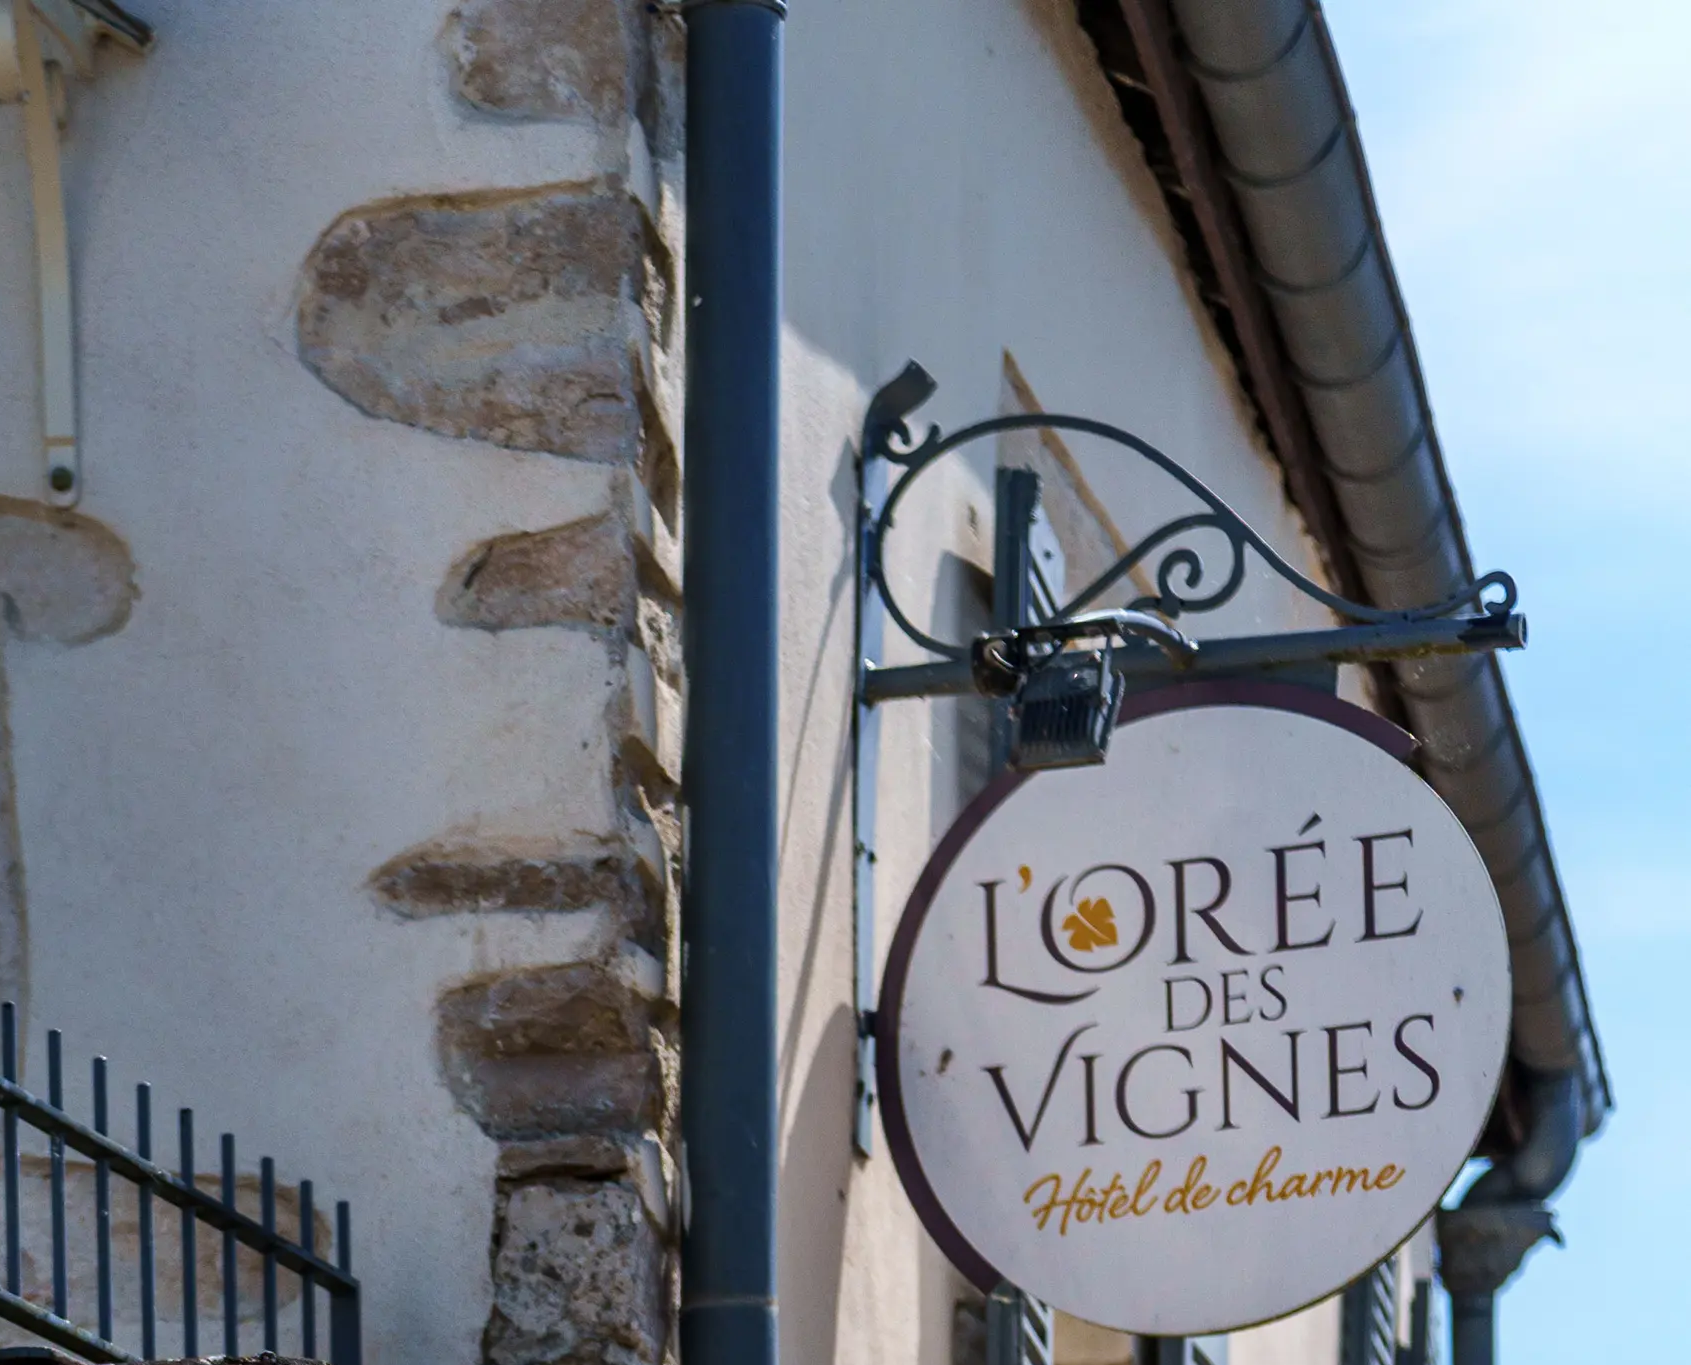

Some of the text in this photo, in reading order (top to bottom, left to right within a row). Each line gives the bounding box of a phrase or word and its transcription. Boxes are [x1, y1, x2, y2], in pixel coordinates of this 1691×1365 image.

[977, 813, 1425, 1006] L'ORÉE
[1163, 964, 1288, 1033] DES
[982, 1013, 1443, 1153] VIGNES
[1023, 1145, 1406, 1237] Hôtel de charme
